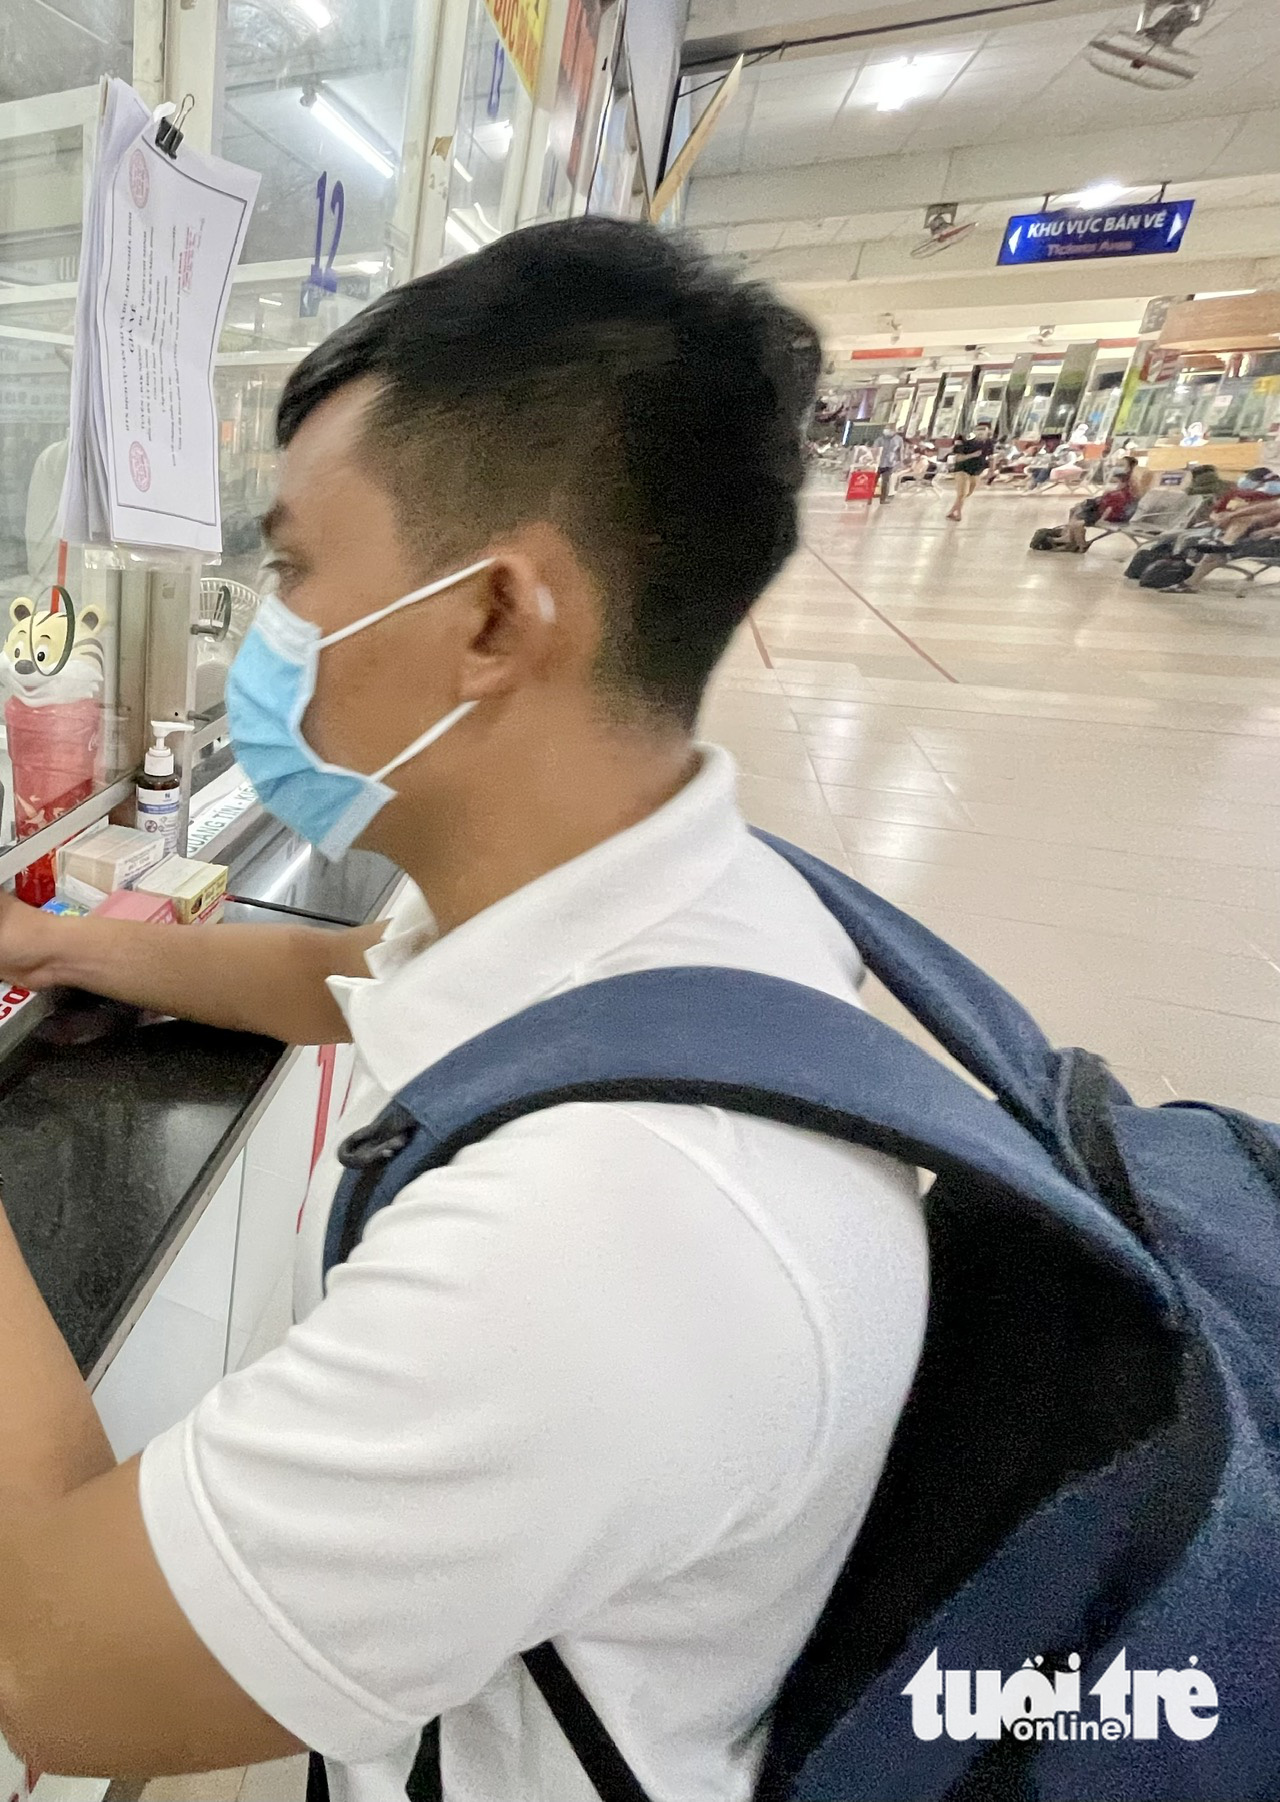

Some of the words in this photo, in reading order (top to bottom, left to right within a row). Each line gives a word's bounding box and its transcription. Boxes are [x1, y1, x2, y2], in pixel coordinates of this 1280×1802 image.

[1027, 221, 1065, 239] KHU
[1066, 215, 1104, 239] VỰC
[1103, 214, 1142, 232] BÁN
[1143, 210, 1168, 229] VÉ
